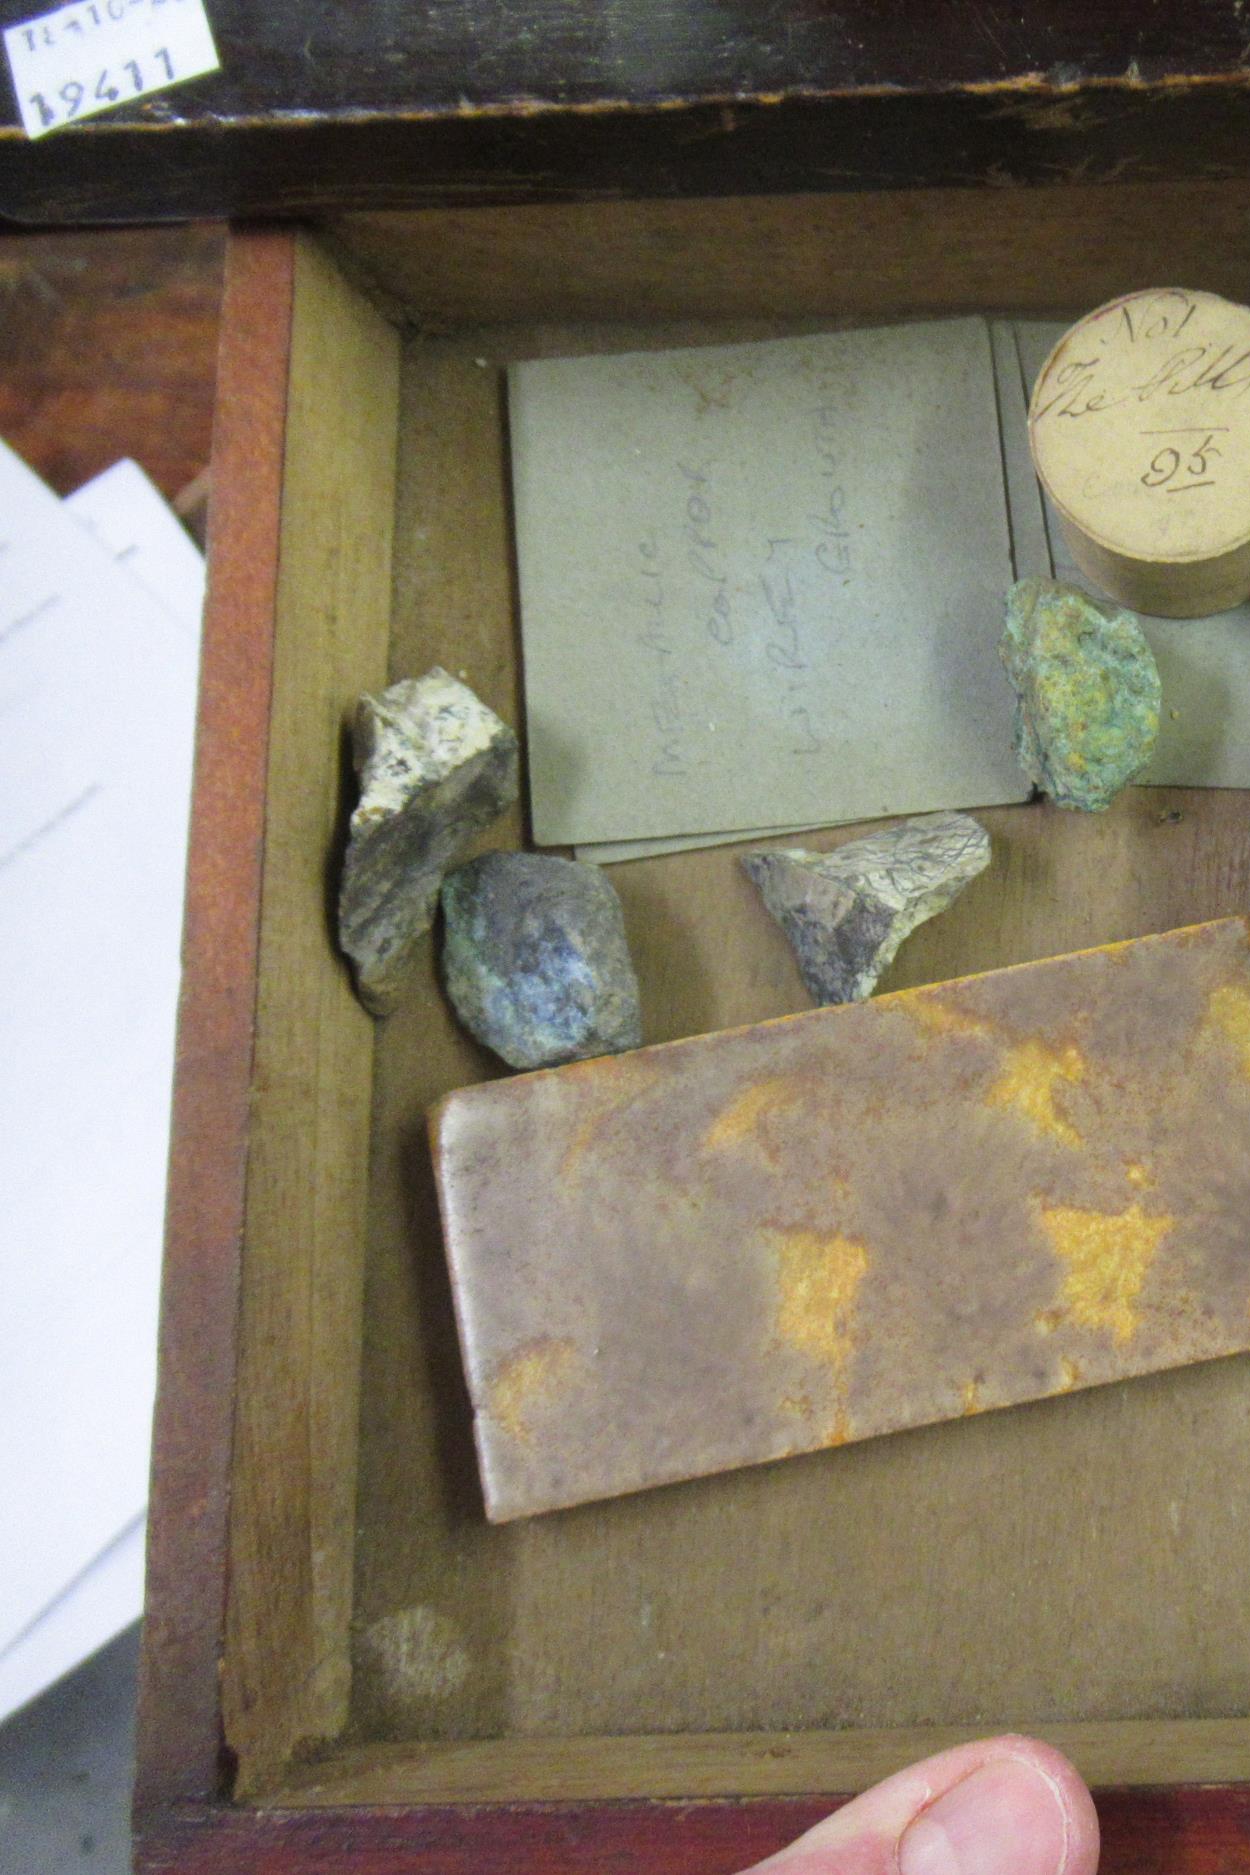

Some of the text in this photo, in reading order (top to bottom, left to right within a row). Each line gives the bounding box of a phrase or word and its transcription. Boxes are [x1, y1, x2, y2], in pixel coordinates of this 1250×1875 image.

[29, 46, 175, 127] 19411
[1035, 359, 1116, 422] The
[1140, 434, 1223, 488] 95
